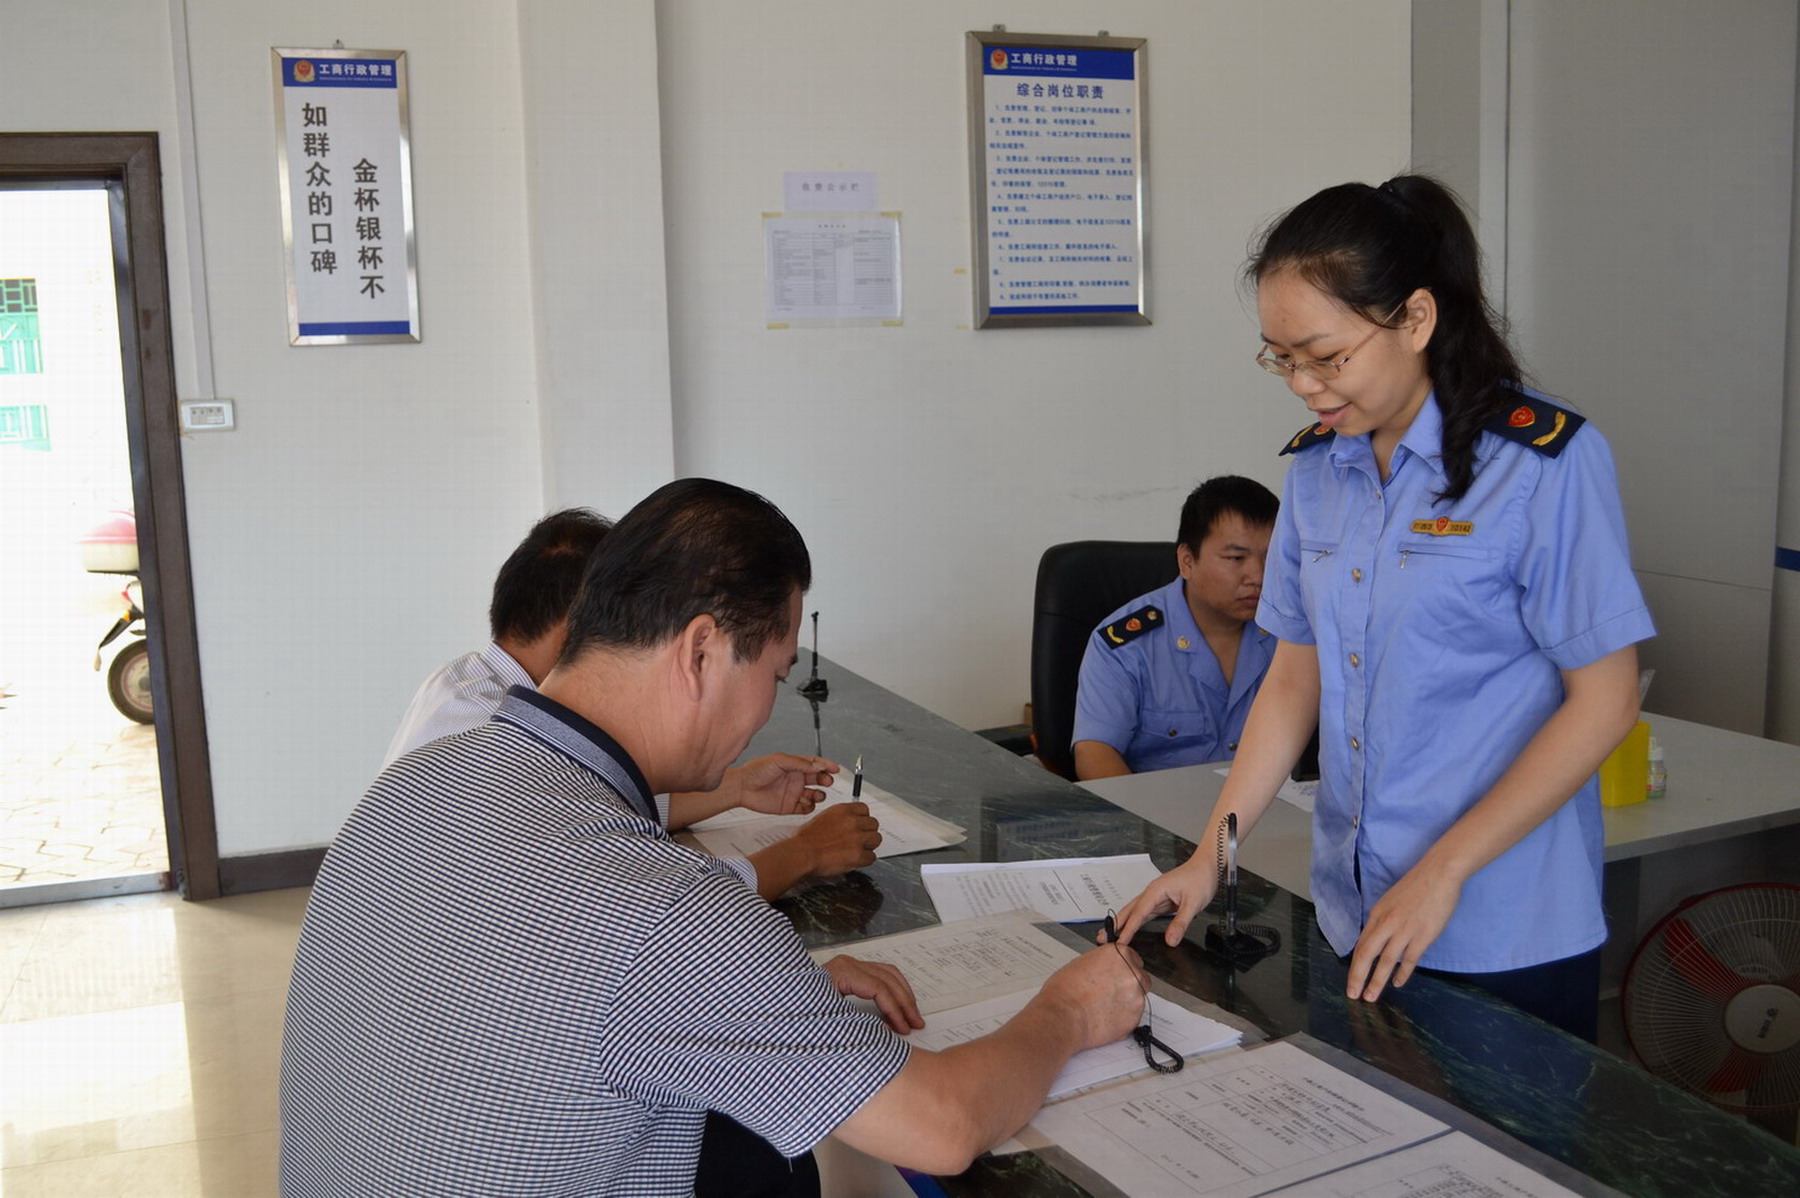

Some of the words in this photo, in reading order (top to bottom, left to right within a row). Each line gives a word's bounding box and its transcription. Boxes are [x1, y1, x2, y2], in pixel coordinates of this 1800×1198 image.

[1010, 53, 1078, 66] 工商行政管理
[319, 63, 392, 76] 工商行政管理
[1016, 82, 1104, 99] 综合岗位职责
[302, 102, 338, 275] 如群众的口碑
[352, 157, 386, 300] 金杯银杯不
